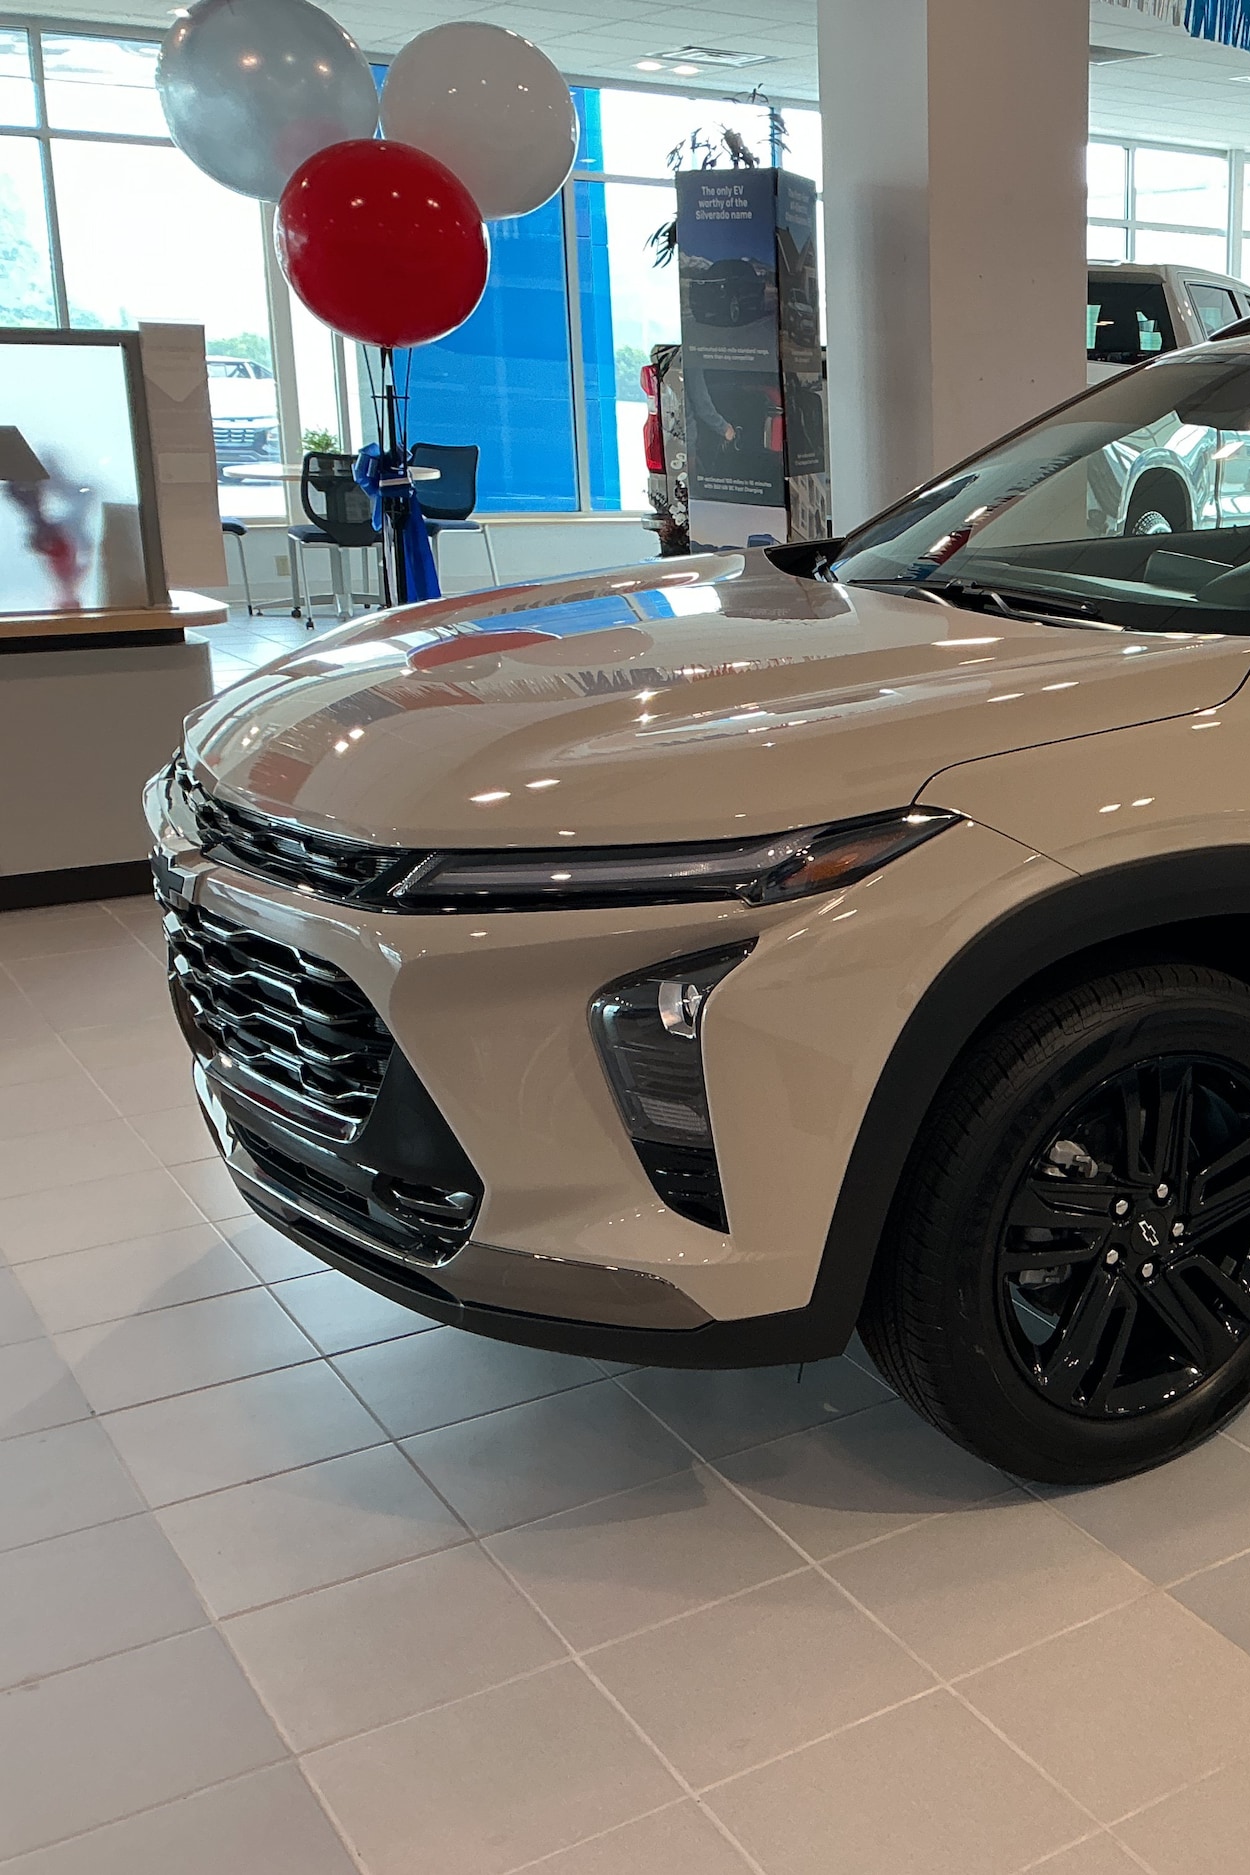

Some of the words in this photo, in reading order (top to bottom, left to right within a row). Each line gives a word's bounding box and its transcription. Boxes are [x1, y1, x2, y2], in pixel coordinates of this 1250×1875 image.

[701, 186, 715, 196] The
[716, 186, 732, 197] only
[733, 185, 744, 195] EV
[698, 198, 724, 209] worthy
[725, 197, 734, 207] of
[735, 198, 748, 207] the
[695, 210, 730, 220] Silverado
[731, 211, 752, 219] name
